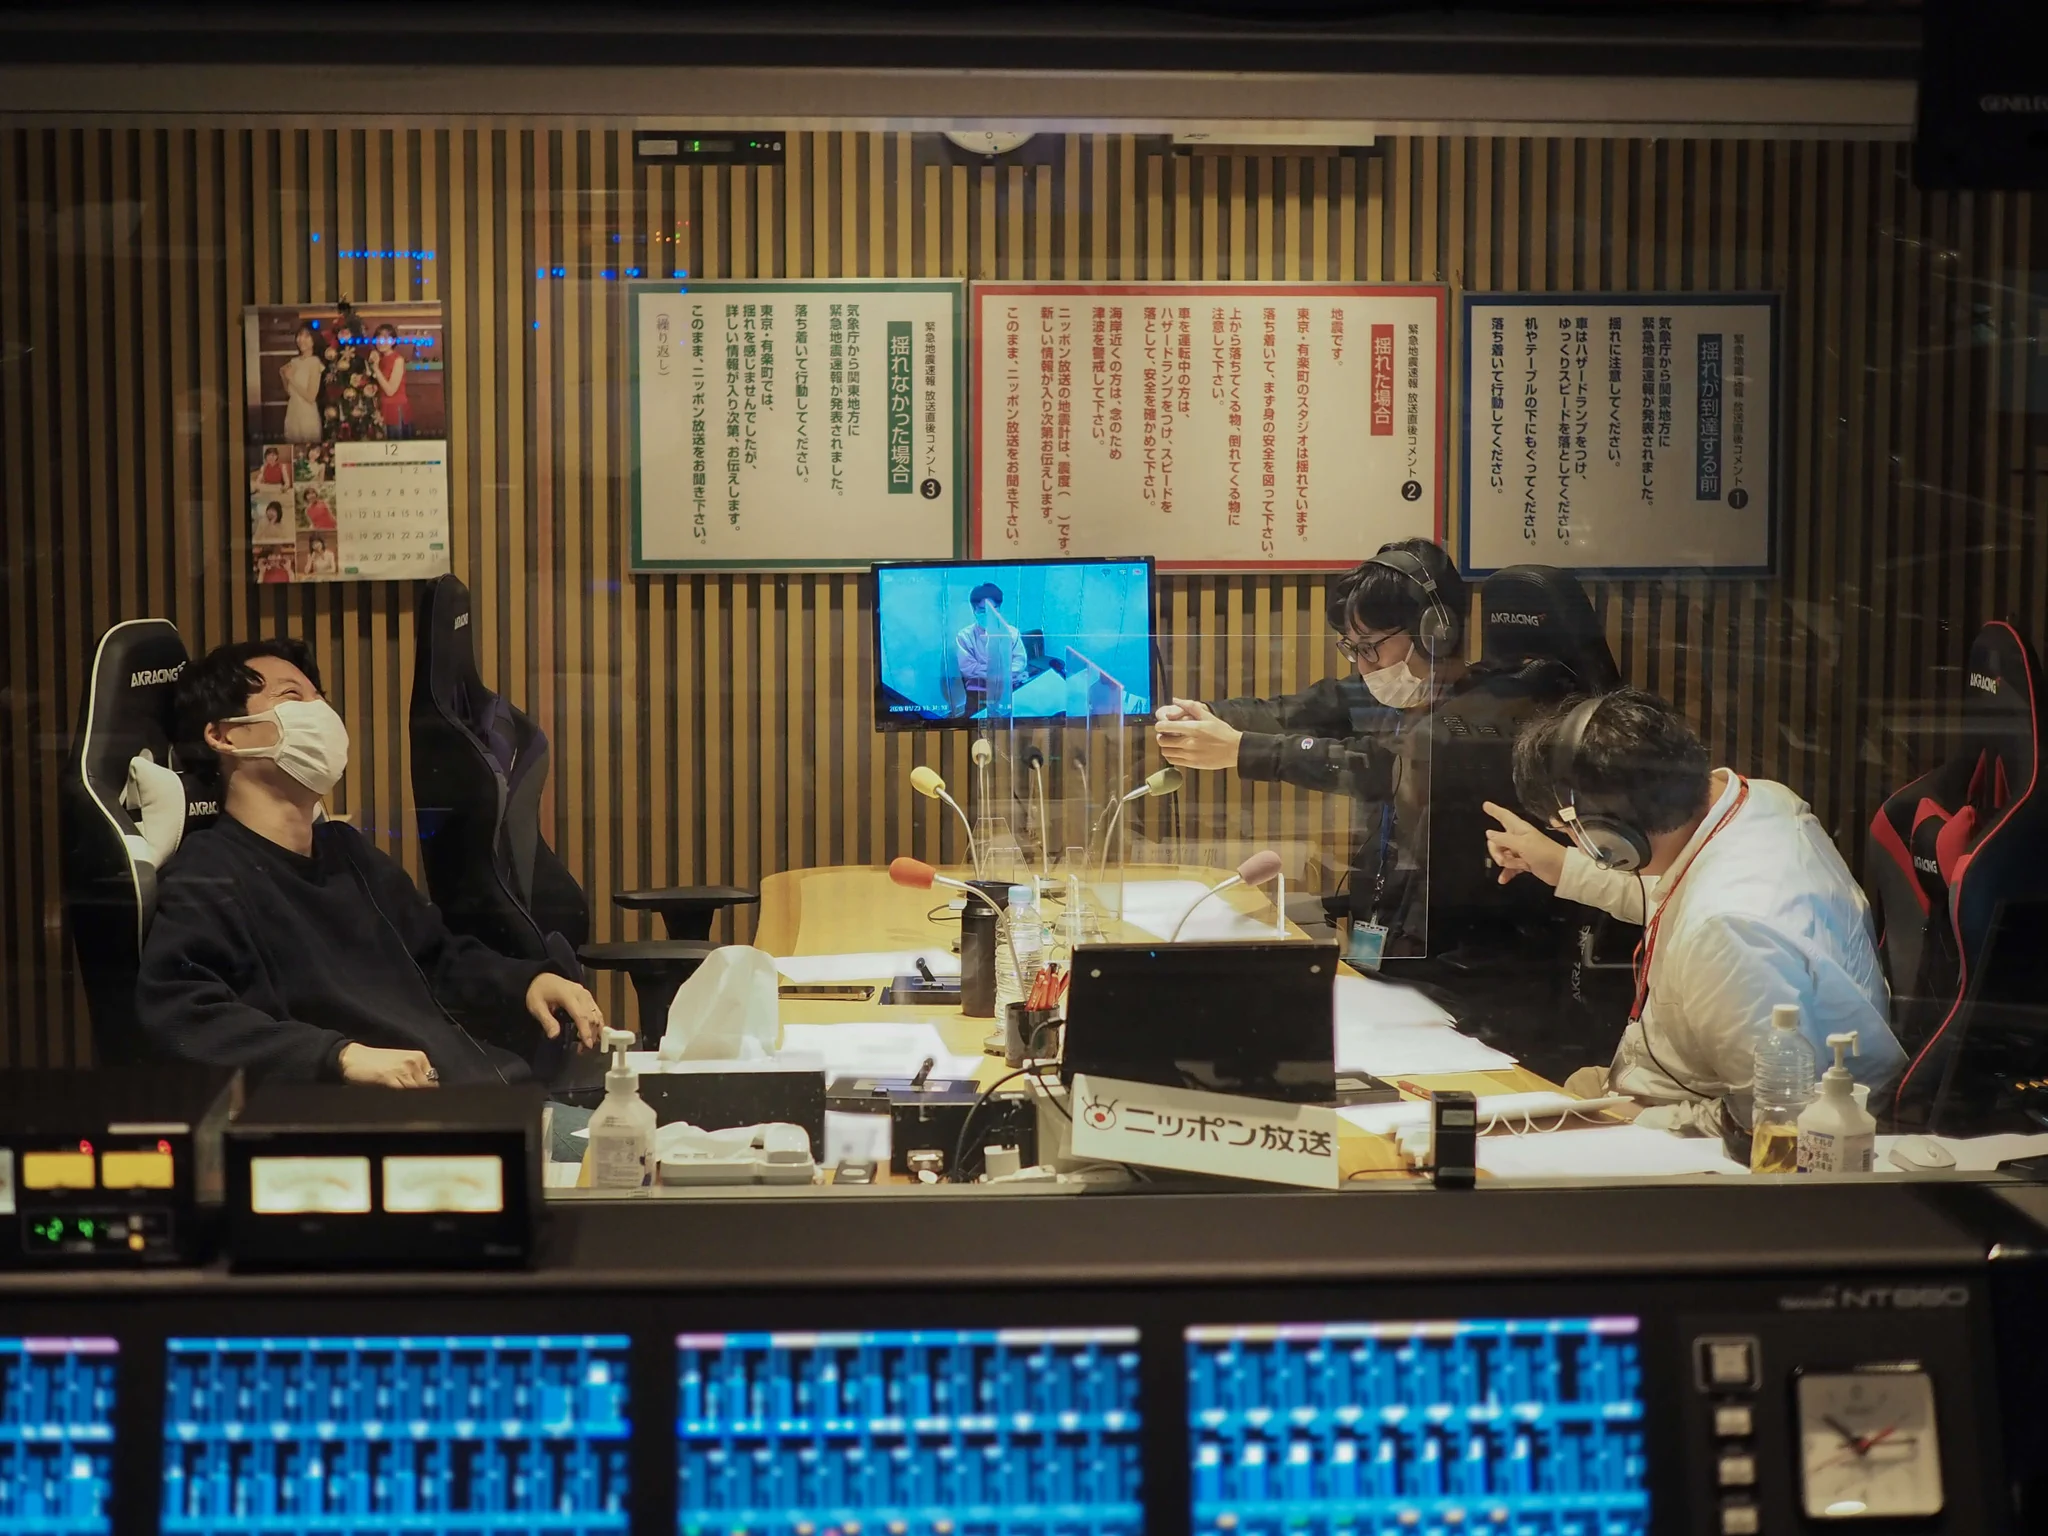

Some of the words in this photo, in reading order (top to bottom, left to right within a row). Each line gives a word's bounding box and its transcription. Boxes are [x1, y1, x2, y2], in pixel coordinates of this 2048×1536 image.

[743, 304, 757, 470] 揺れを感じませんでしたが、
[760, 304, 774, 412] 東京・有楽町では、
[795, 304, 809, 483] 落ち着いて行動してください。
[829, 304, 844, 496] 緊急地震速報が発表されました。
[847, 304, 860, 437] 気象庁から関東地方に
[890, 335, 910, 484] 揺れなかった場合
[924, 321, 936, 387] 緊急地震速報
[1092, 306, 1106, 446] 津波を警戒して下さい。
[1109, 306, 1123, 461] 海岸近くの方は、念のため
[1143, 307, 1157, 506] 落として、安全を確かめて下さい。
[1178, 307, 1191, 419] 車を運転中の方は、
[1211, 307, 1225, 406] 注意して下さい。
[1330, 307, 1344, 366] 地震です。
[1374, 336, 1392, 425] 揺れた場合
[1407, 323, 1419, 389] 緊急地震速報
[1490, 316, 1505, 495] 落ち着いて行動してください。
[1608, 316, 1622, 468] 揺れに注意してください。
[1658, 316, 1672, 448] 気象庁から関東地方に
[384, 443, 399, 456] 12
[691, 304, 706, 545] このまま、ニッポン放送をお聞き下さい。
[726, 304, 741, 532] 詳しい情報が入り次第、お伝えします。
[924, 389, 936, 477] 放送直後コメント
[1006, 306, 1020, 546] このまま、ニッポン放送をお聞き下さい。
[1040, 306, 1054, 525] 新しい情報が入り次第お伝えします。
[1228, 307, 1242, 526] 上から落ちてくる物、倒れてくる物に
[1296, 307, 1310, 542] 東京・有楽町のスタジオは揺れています。
[1407, 392, 1419, 478] 放送直後コメント
[1523, 316, 1539, 547] 机やテーブルの下にもぐってください。
[1557, 316, 1572, 546] ゆっくりスピードを落としてください。
[1700, 341, 1719, 492] 揺れが到達する前
[130, 667, 179, 688] AKRACING
[1490, 612, 1540, 627] AKRACING
[1125, 1106, 1332, 1157] ニッポン放送
